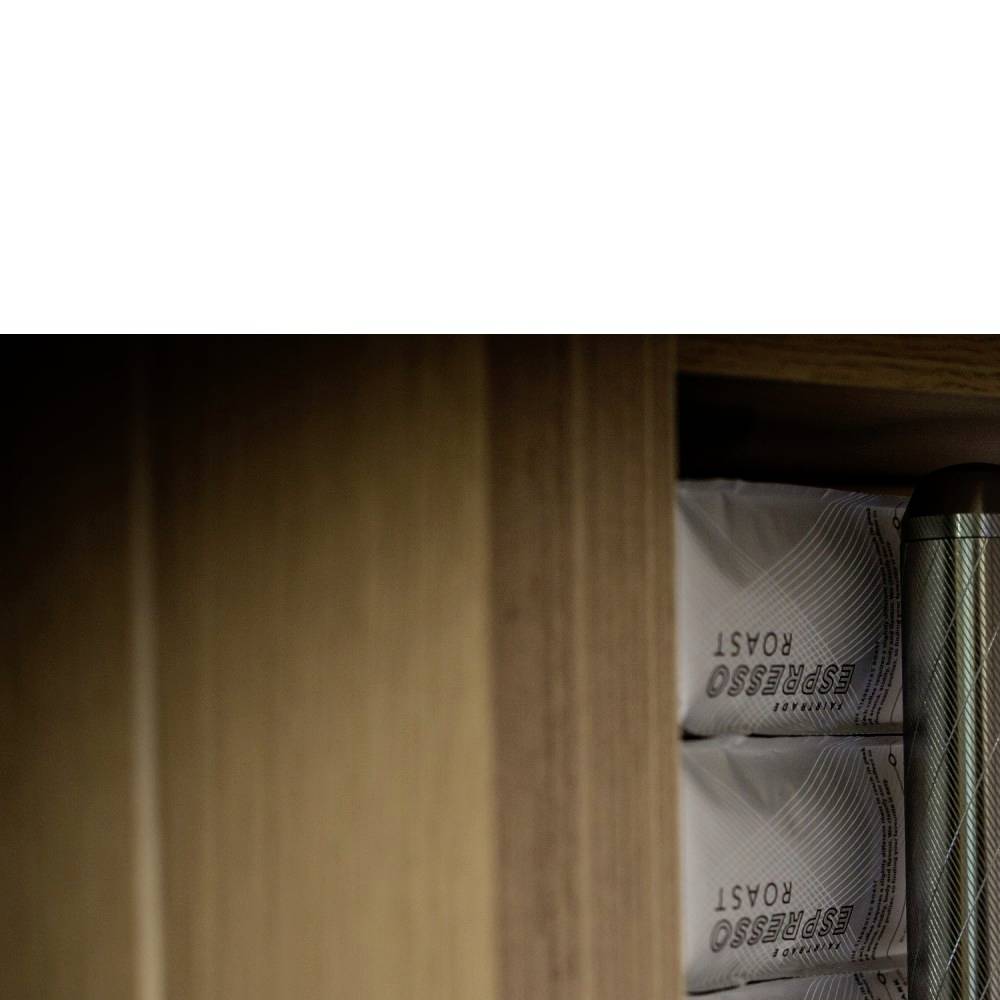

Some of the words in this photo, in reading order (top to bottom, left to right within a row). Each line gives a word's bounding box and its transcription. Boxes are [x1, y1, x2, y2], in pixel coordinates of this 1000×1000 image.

[714, 631, 793, 656] ROAST
[706, 664, 856, 698] ESPRESSO
[773, 701, 842, 713] FAIRTRADE
[715, 882, 793, 911] ROAST
[710, 905, 854, 952] ESPRESSO
